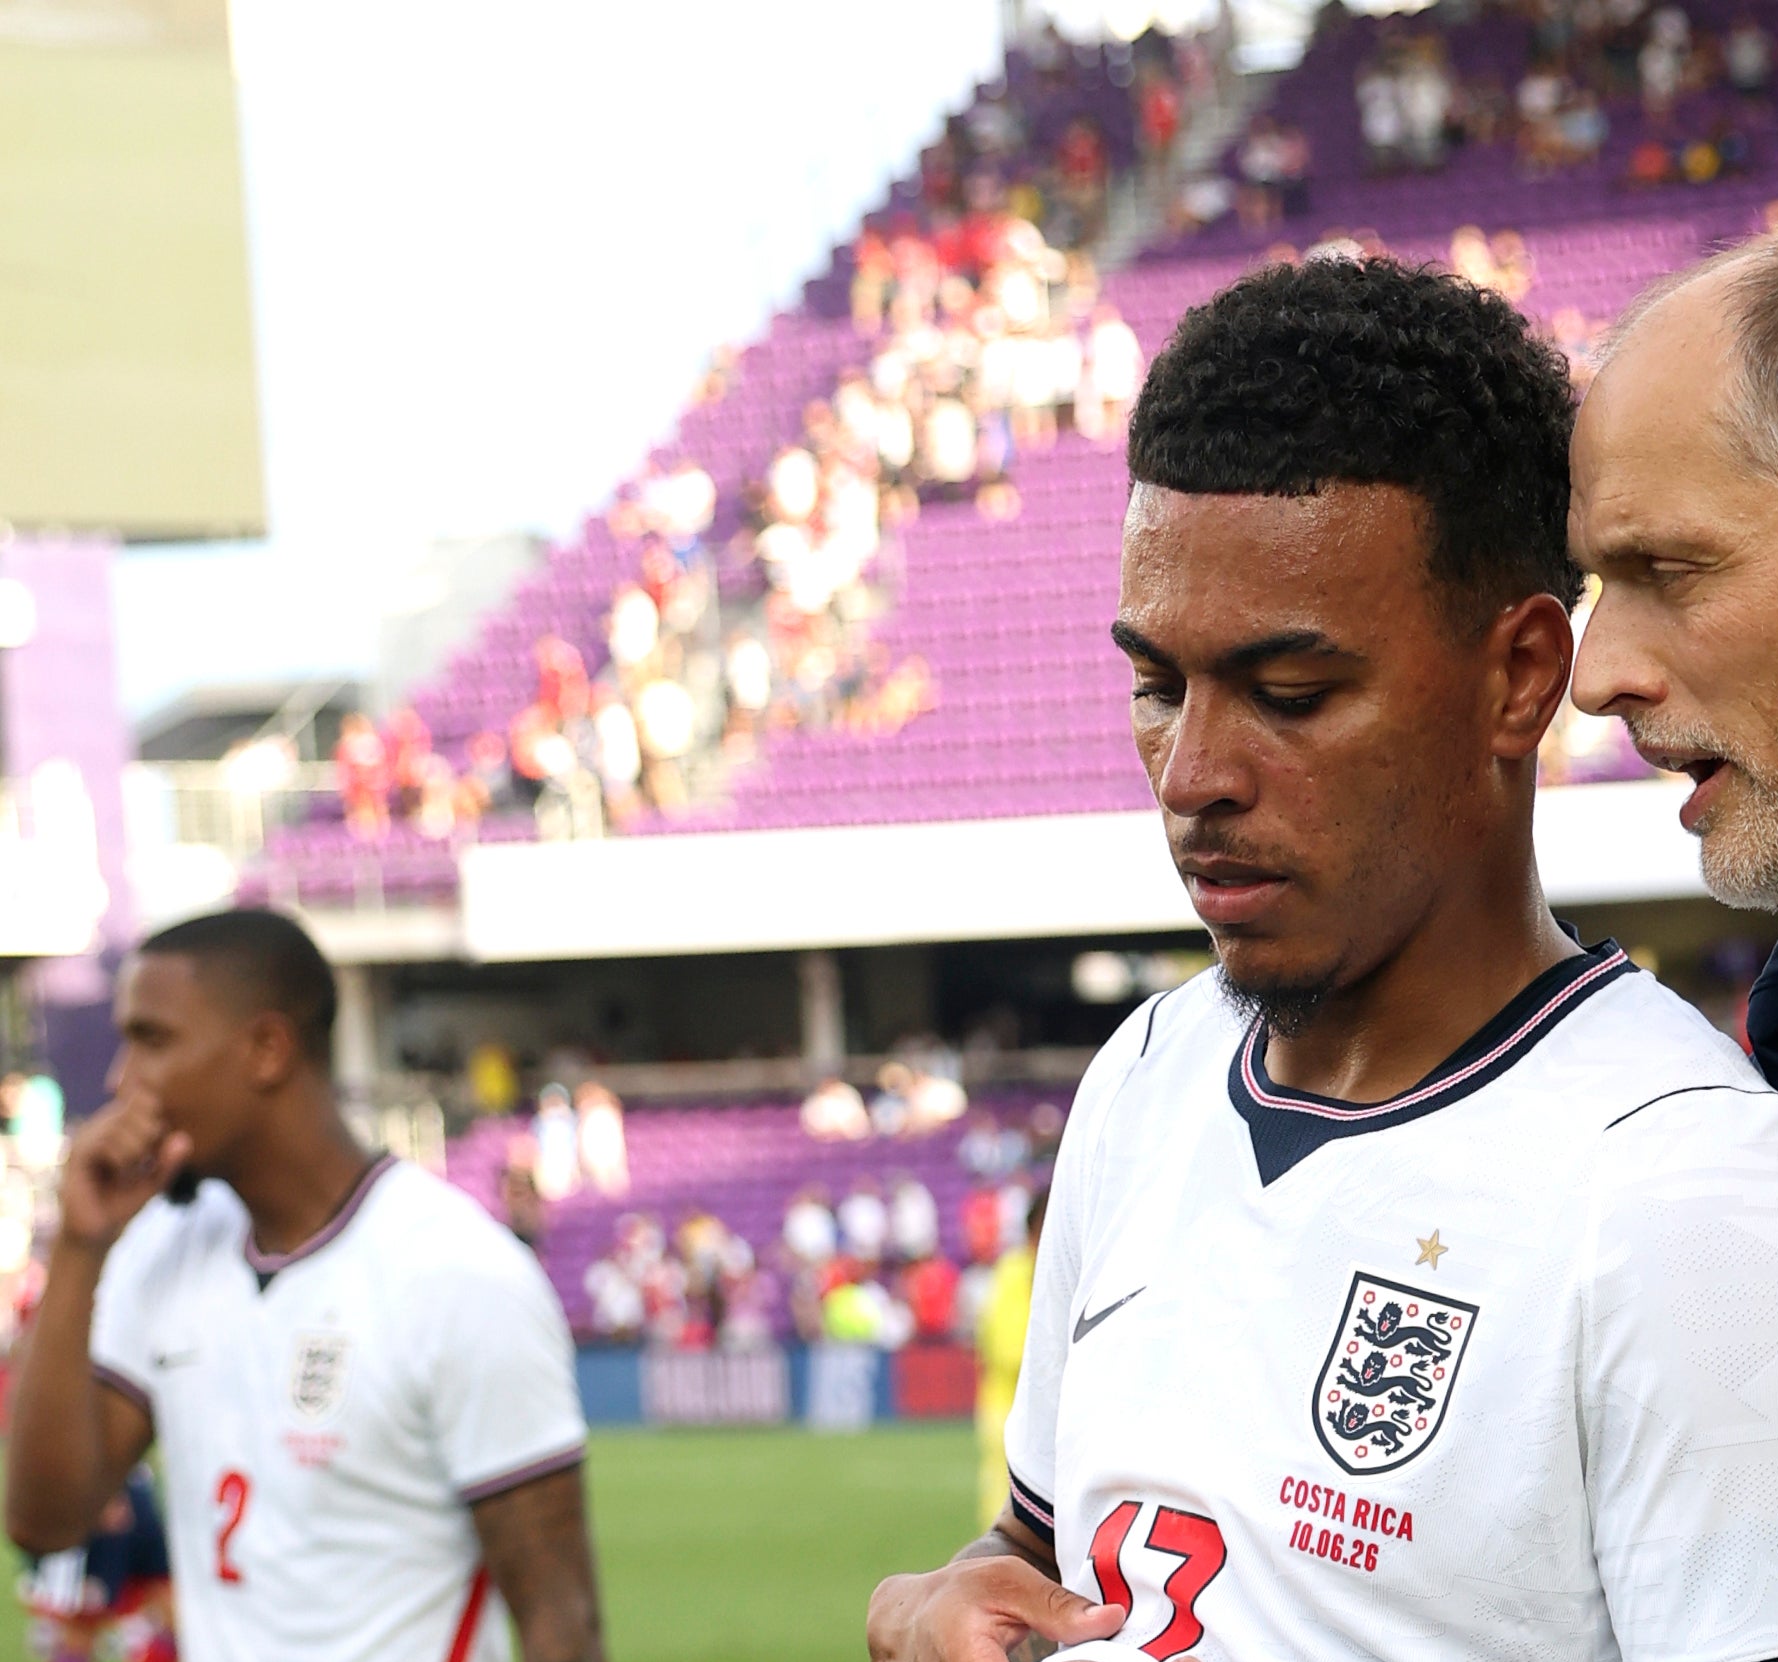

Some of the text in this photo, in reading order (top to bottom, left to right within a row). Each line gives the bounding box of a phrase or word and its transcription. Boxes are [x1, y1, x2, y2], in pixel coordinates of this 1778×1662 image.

[213, 1467, 251, 1585] 2
[1279, 1475, 1414, 1542] COSTA RICA
[1288, 1519, 1380, 1573] 10.06.26
